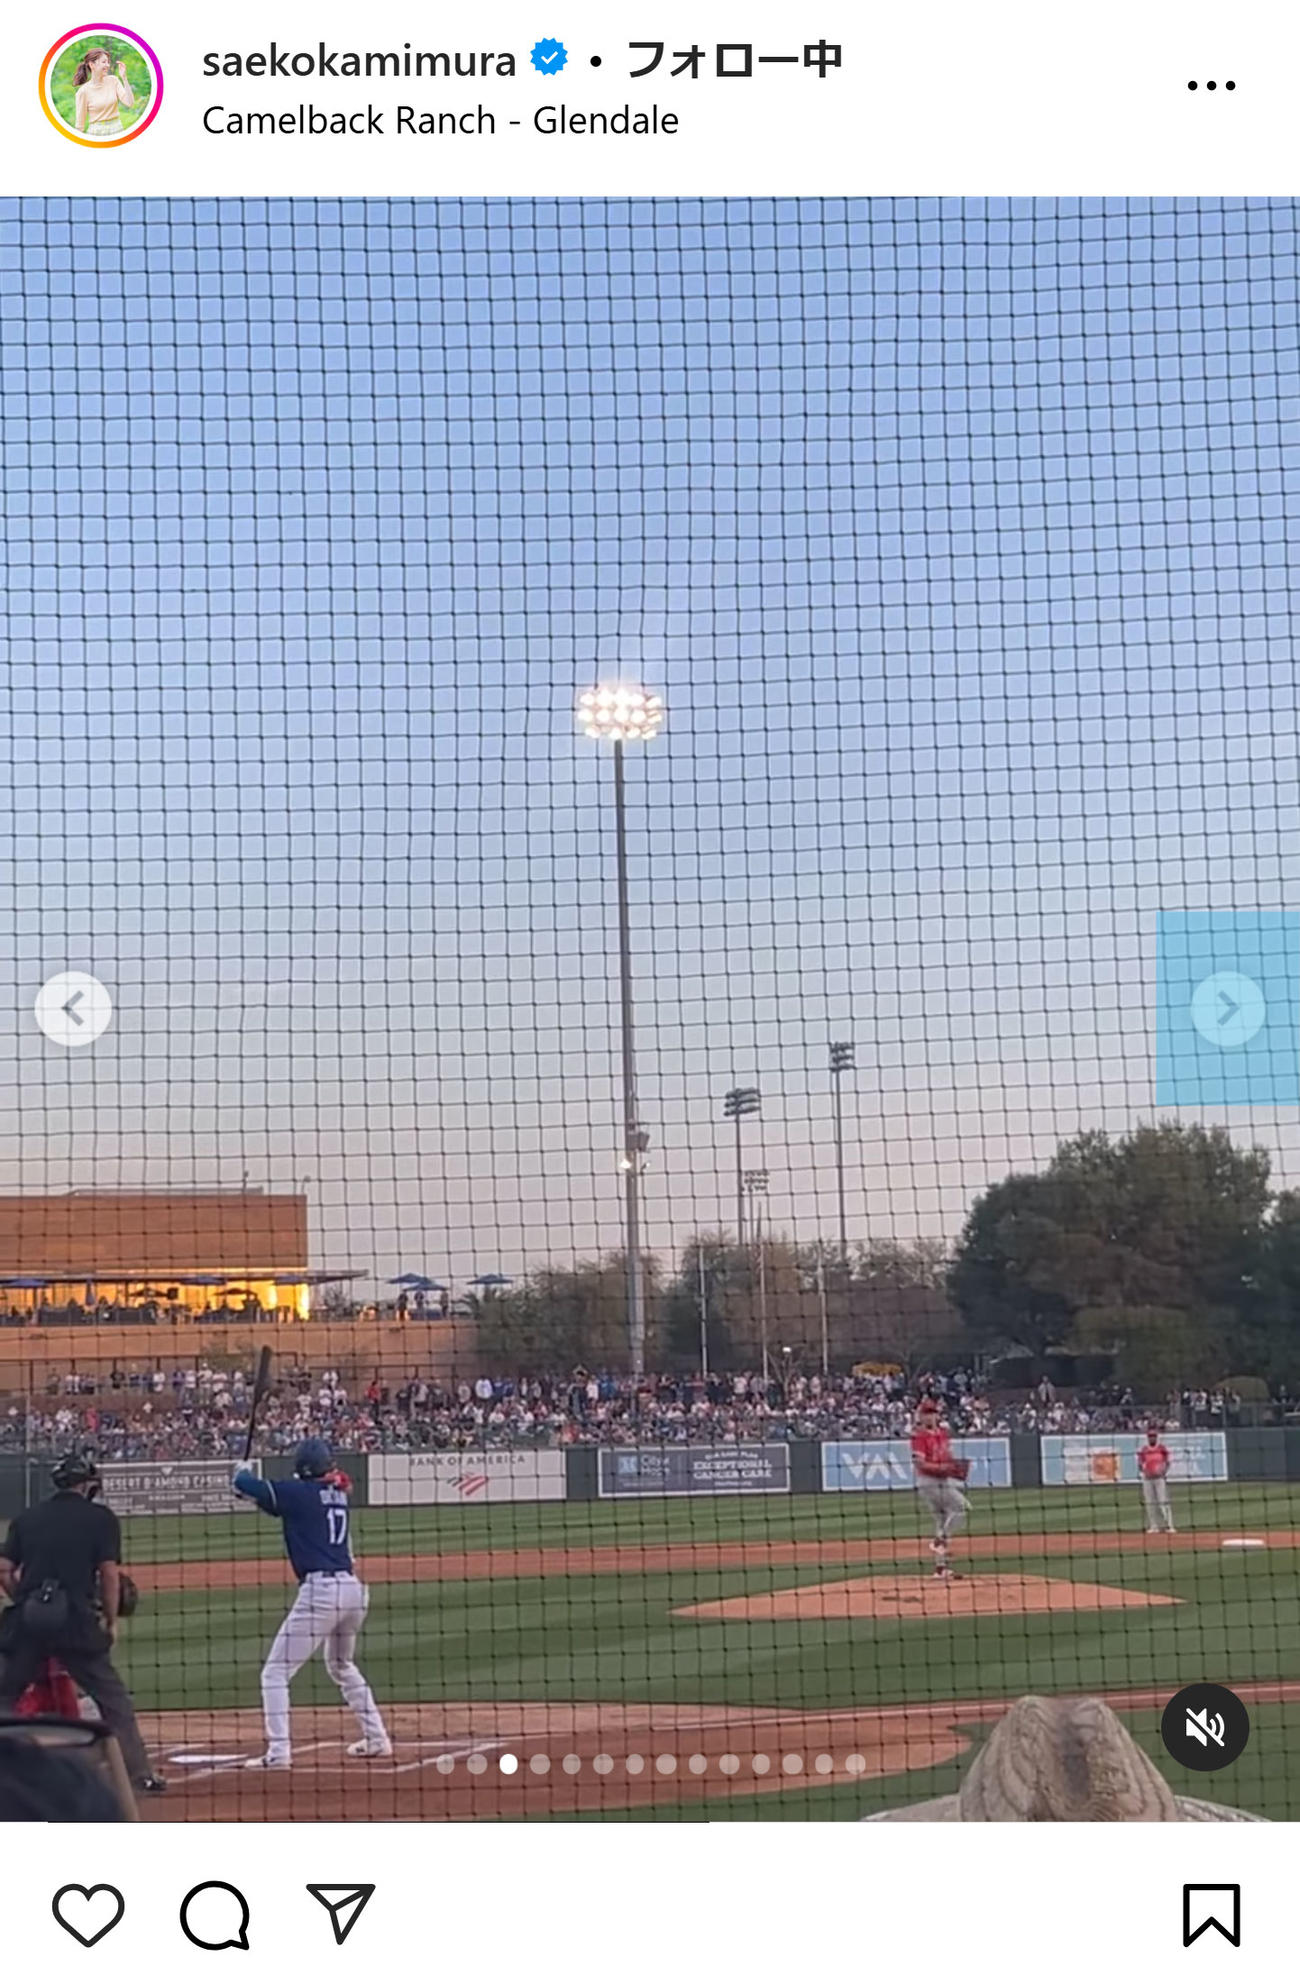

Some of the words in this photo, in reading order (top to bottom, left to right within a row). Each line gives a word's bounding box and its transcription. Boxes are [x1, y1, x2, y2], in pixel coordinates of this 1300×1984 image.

[409, 1457, 443, 1466] BANK
[467, 1455, 525, 1465] AMERICA
[102, 1477, 140, 1491] DESERT
[326, 1507, 347, 1545] 17
